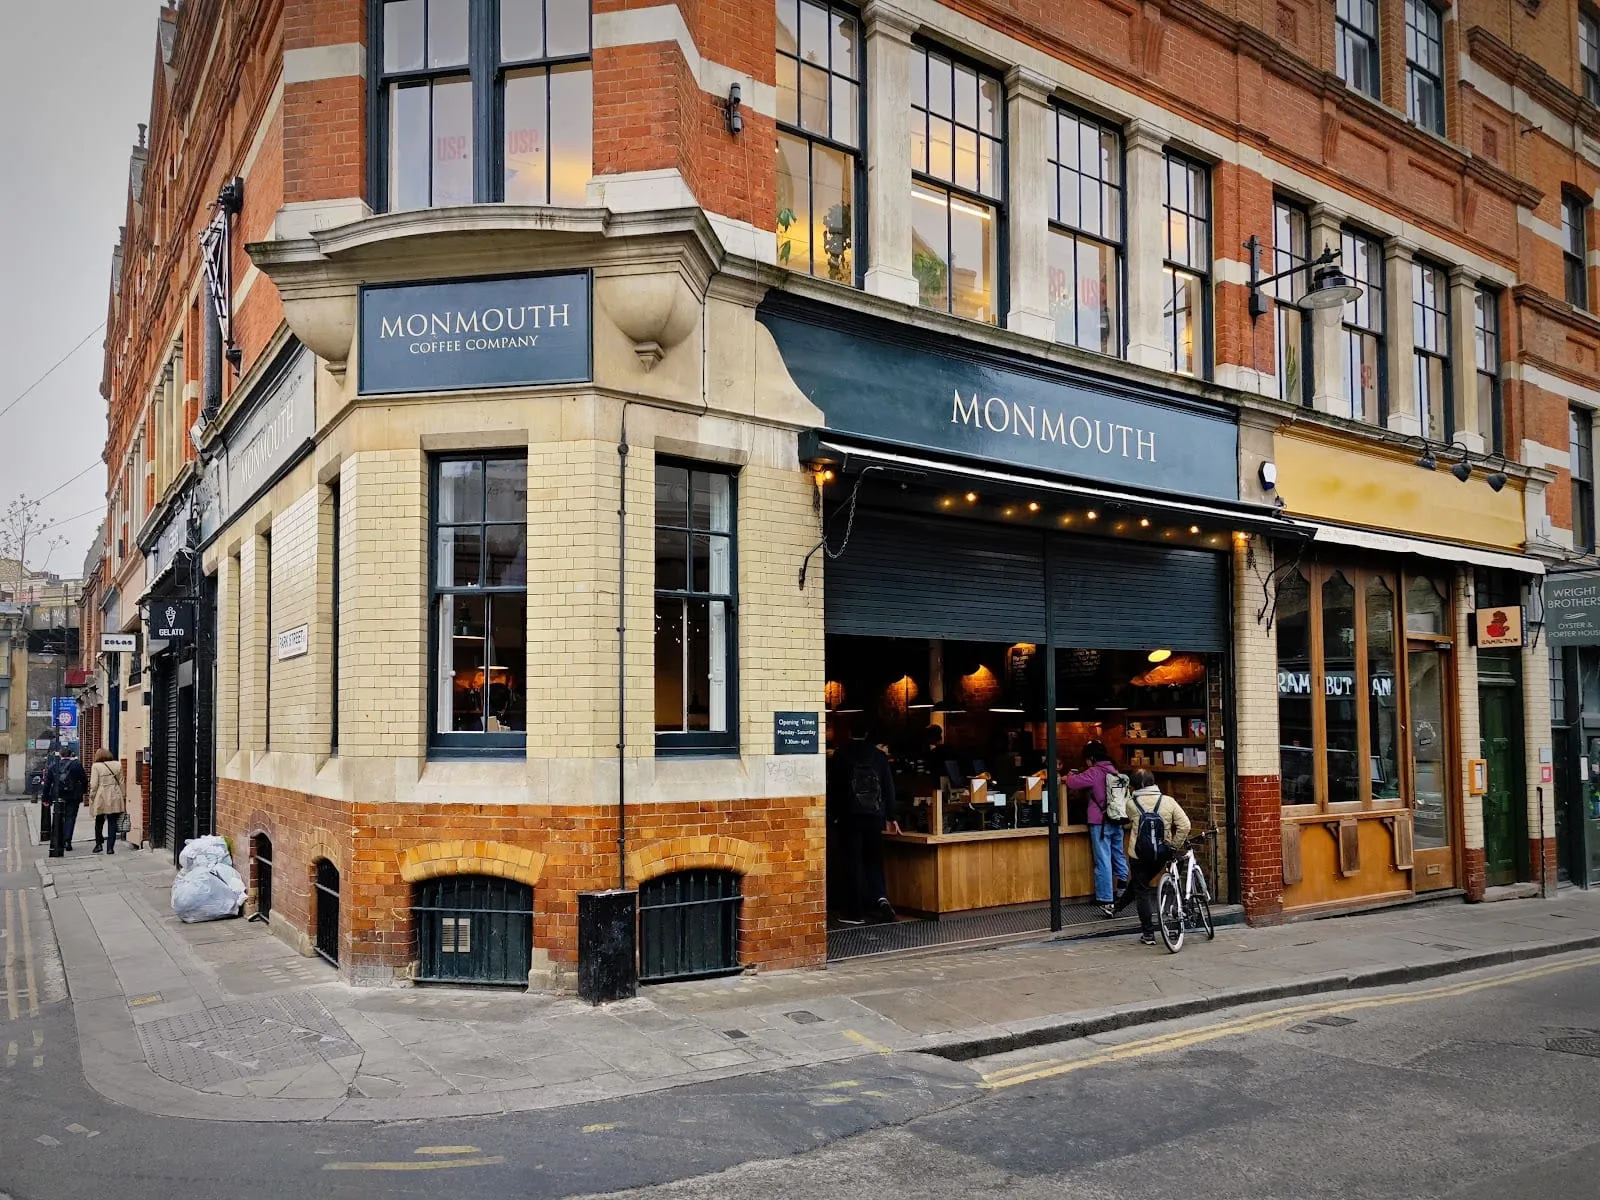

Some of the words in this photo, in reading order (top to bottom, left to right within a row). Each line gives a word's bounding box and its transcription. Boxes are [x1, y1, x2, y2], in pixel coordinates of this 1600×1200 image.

[379, 303, 571, 339] MONMOUTH
[409, 340, 461, 354] COFFEE
[465, 335, 539, 351] COMPANY
[951, 389, 1157, 463] MONMOUTH
[240, 399, 295, 485] MONMOUTH
[1553, 586, 1597, 597] WRIGHT
[158, 628, 185, 636] GELATO
[1558, 622, 1585, 630] OYSTER
[1278, 672, 1311, 694] RAM
[1325, 676, 1353, 696] BUT
[1371, 678, 1392, 697] AN
[778, 718, 799, 727] Opening
[801, 718, 816, 726] Times
